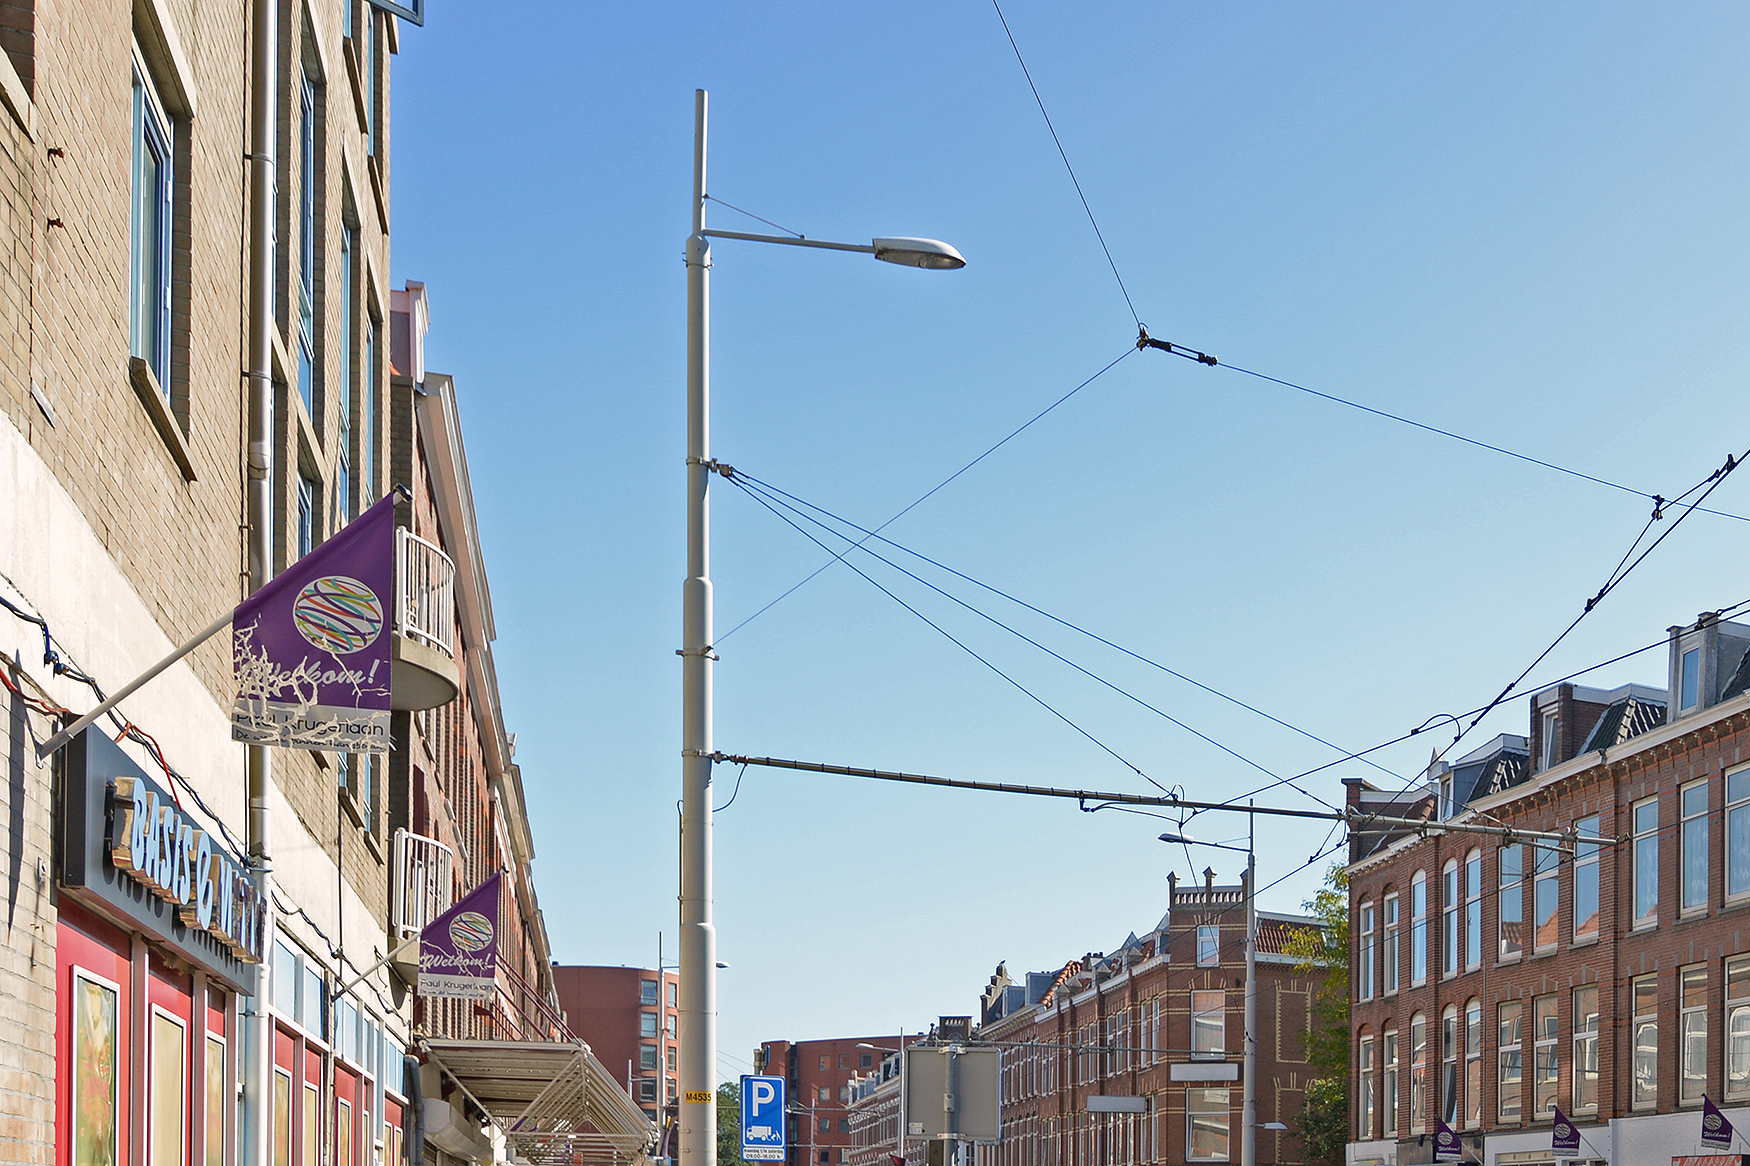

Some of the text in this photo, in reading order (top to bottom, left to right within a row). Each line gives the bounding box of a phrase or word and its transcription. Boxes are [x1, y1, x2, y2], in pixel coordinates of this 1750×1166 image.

[258, 658, 380, 686] elkom!
[131, 777, 194, 906] BASIS
[425, 952, 492, 968] Welkom!
[444, 980, 493, 991] Krugeran
[686, 1092, 712, 1102] M4535
[752, 1081, 775, 1117] P
